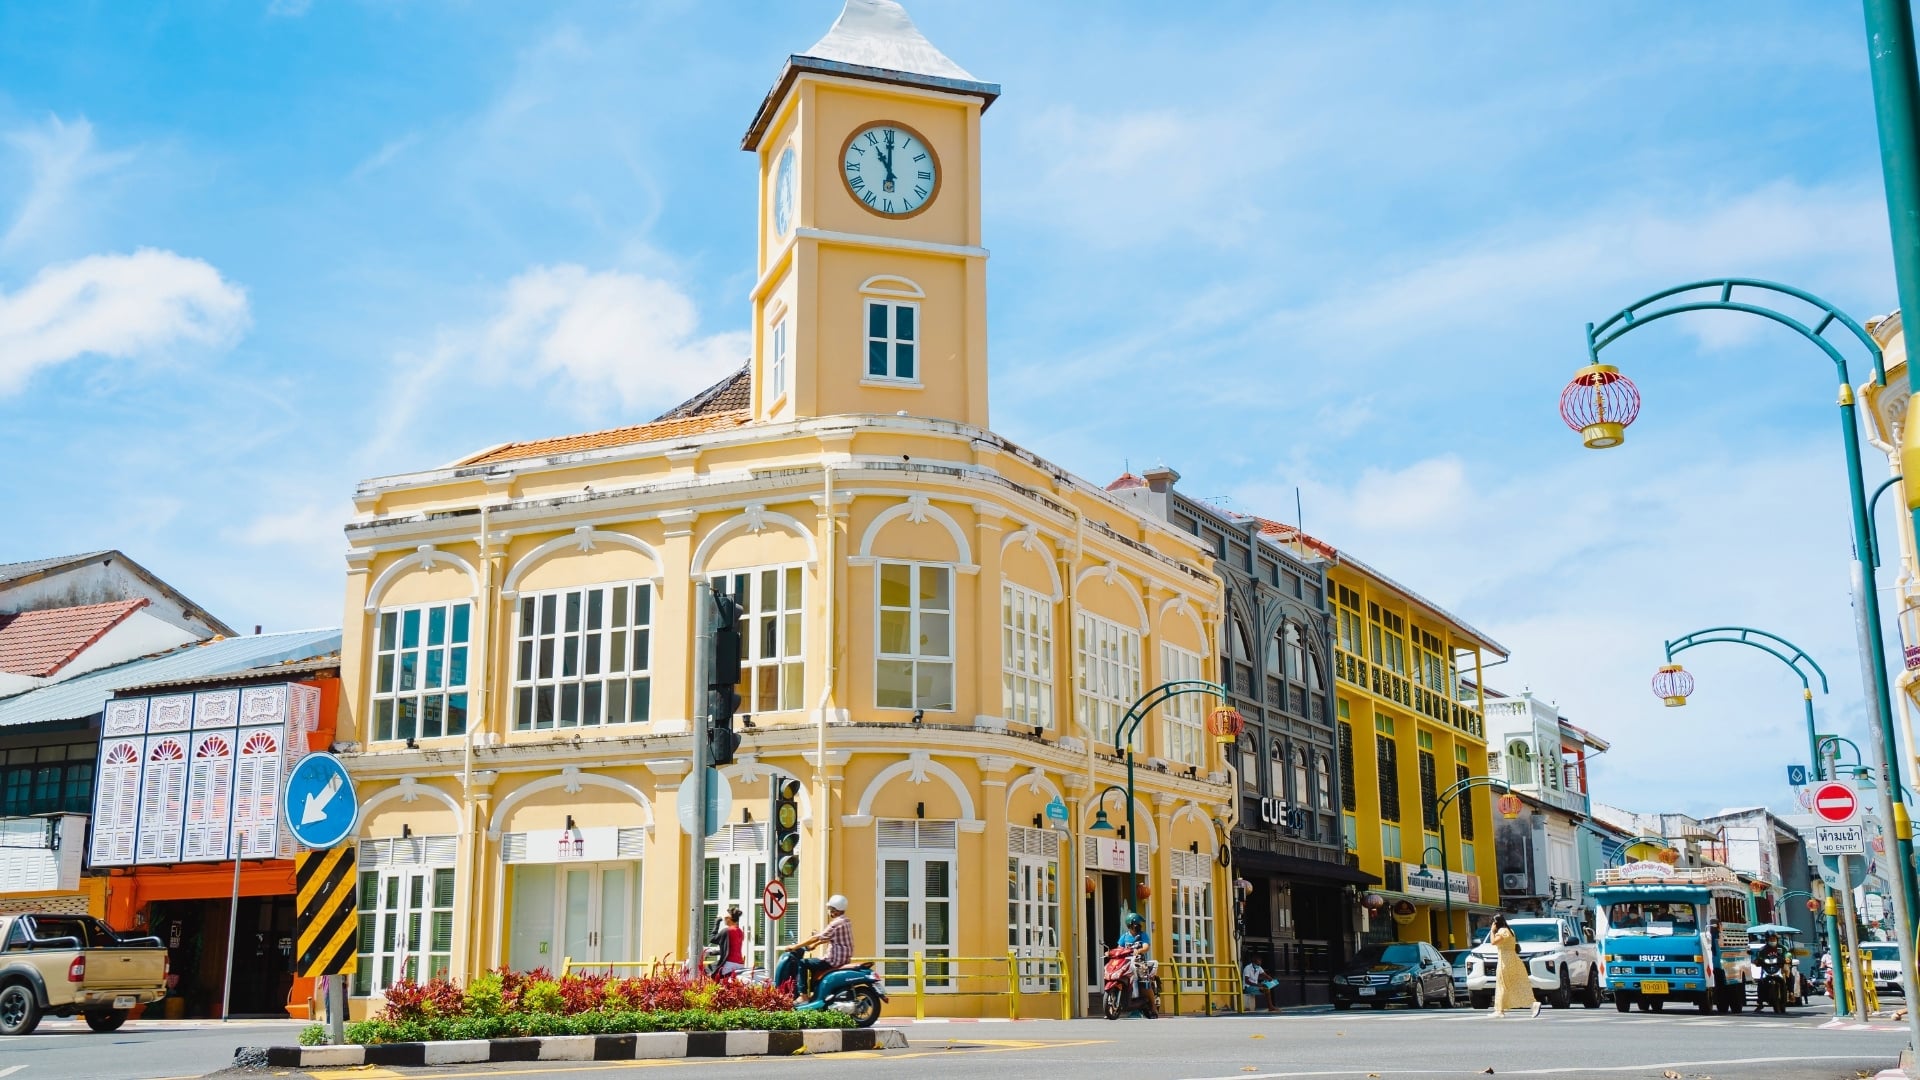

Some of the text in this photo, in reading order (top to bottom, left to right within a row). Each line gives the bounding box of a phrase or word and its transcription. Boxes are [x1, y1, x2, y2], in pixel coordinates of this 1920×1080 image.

[864, 131, 879, 146] XI
[883, 129, 896, 144] XI
[902, 137, 911, 150] I
[851, 143, 865, 156] X
[913, 152, 926, 163] II
[846, 161, 860, 171] IX
[918, 171, 931, 180] III
[849, 175, 866, 194] VIII
[863, 190, 878, 207] VII
[913, 184, 928, 200] IV
[883, 198, 895, 213] VI
[903, 197, 913, 211] V
[1819, 828, 1860, 841] ห้ามเข้า
